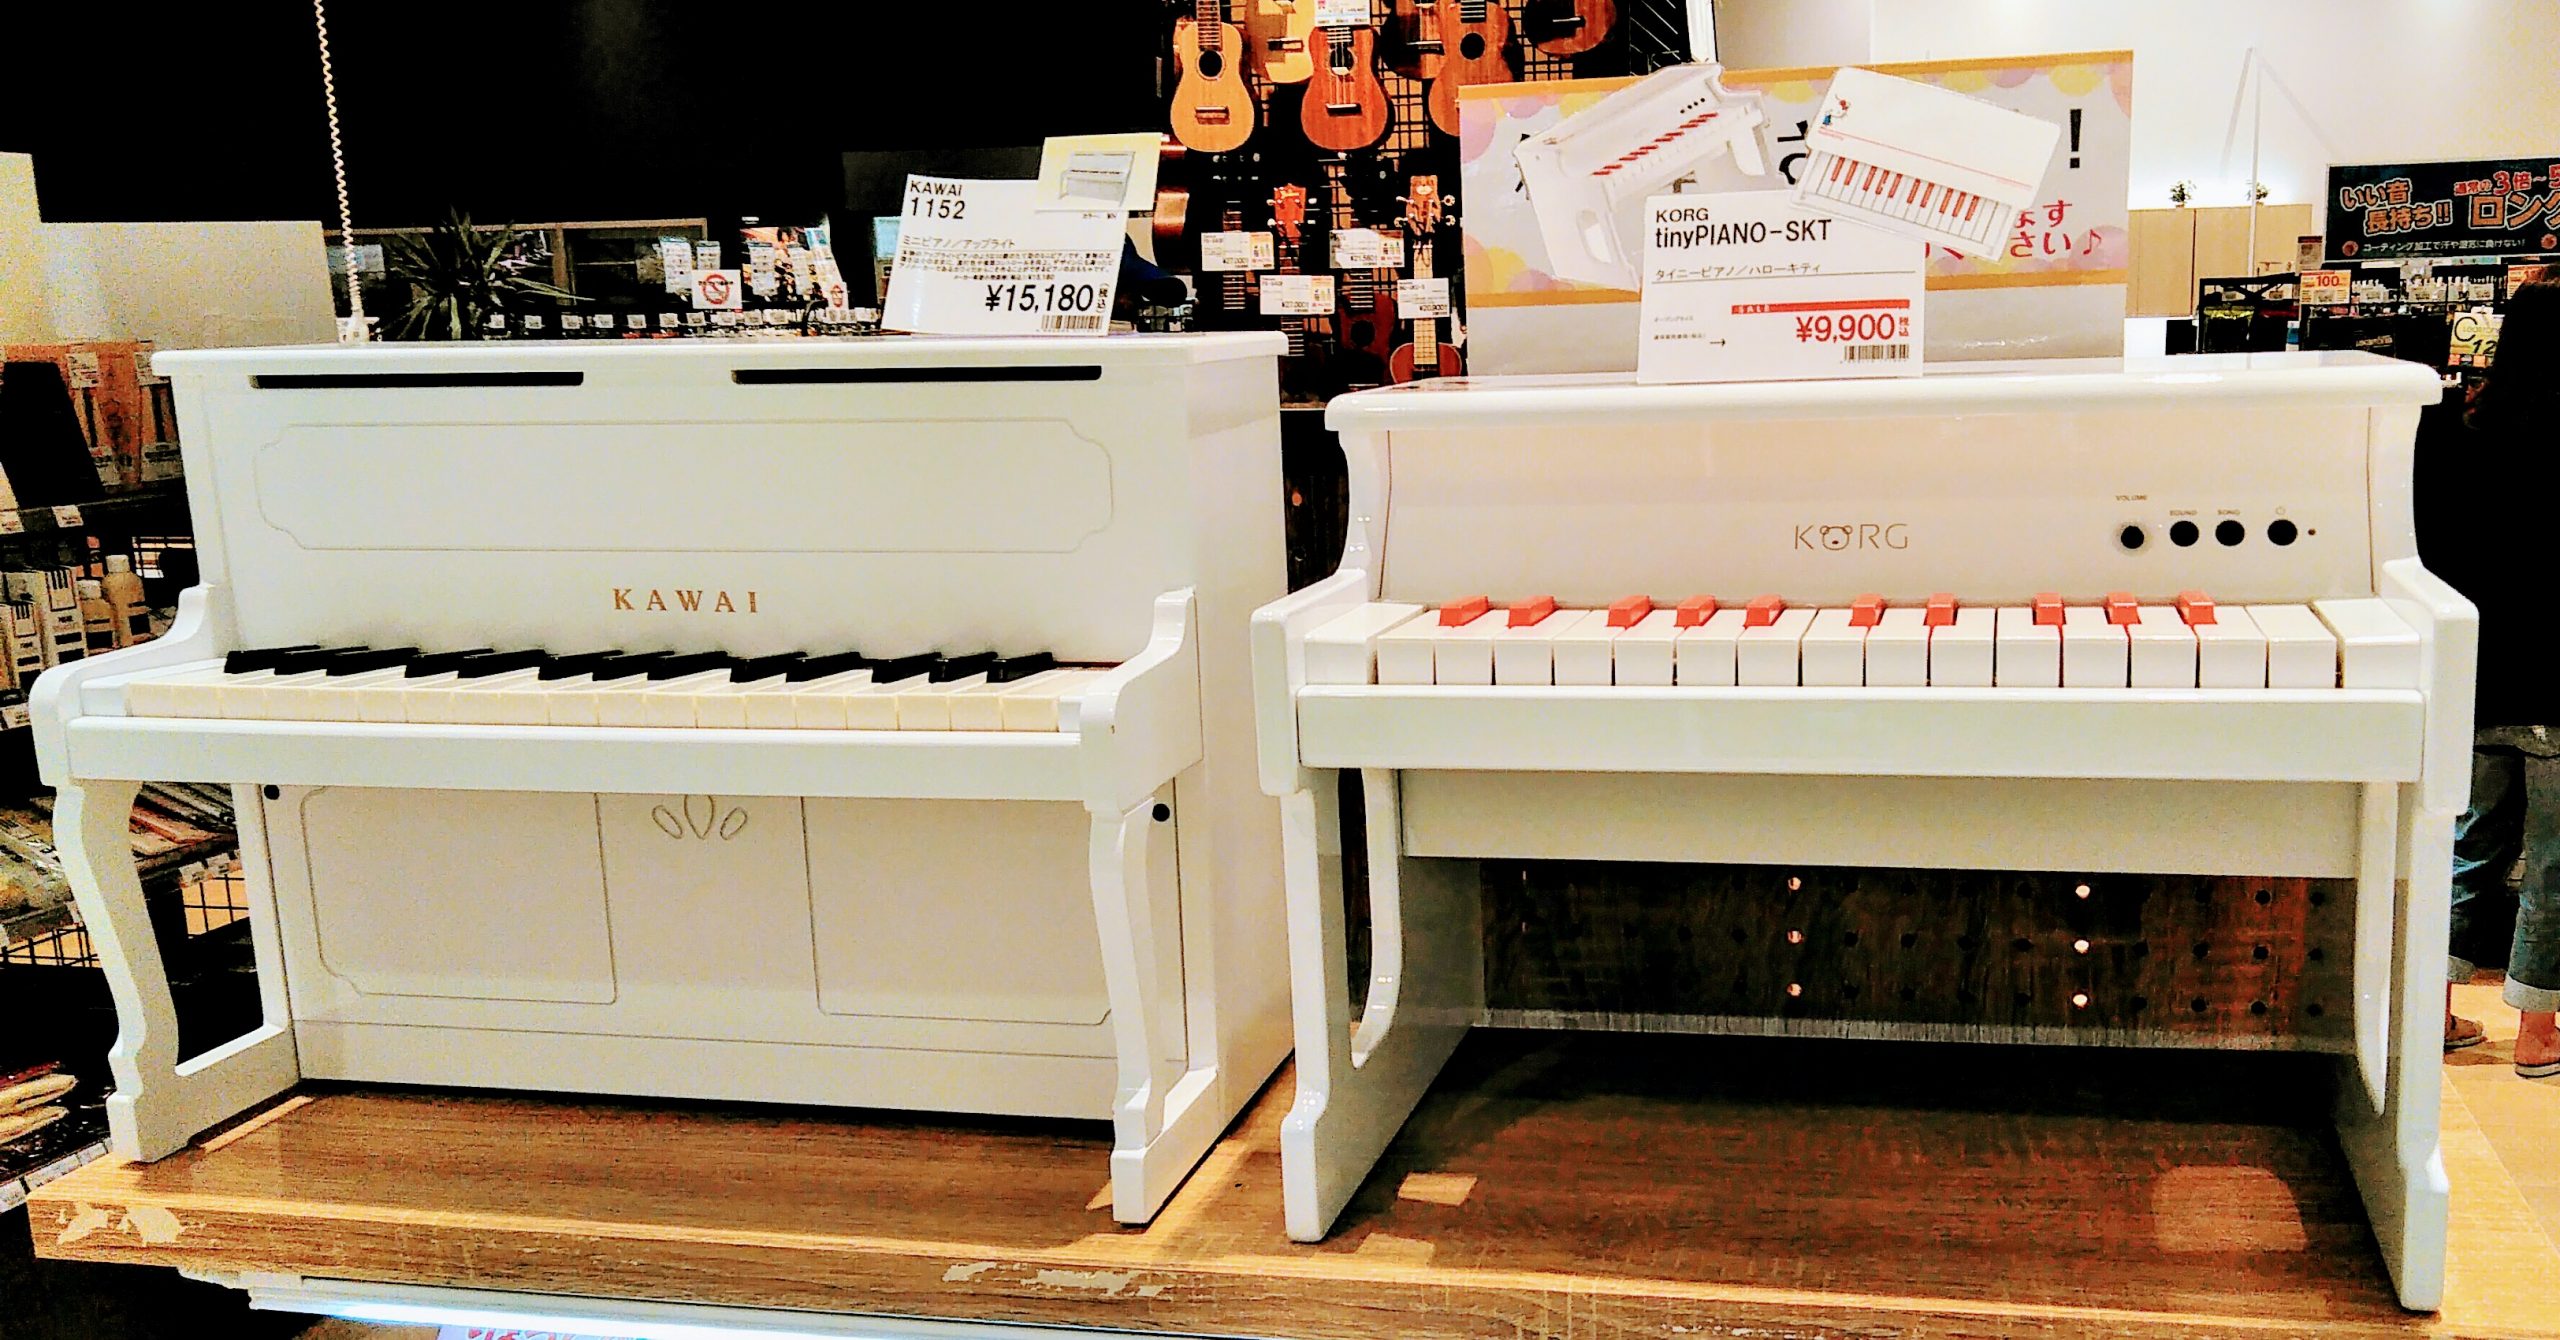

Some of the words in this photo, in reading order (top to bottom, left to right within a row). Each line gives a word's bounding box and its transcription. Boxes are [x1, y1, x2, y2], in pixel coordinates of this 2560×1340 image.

[909, 180, 963, 197] KAWAI
[2340, 176, 2413, 212] いい音
[910, 197, 965, 220] 1152
[1656, 207, 1710, 223] KORG
[1655, 218, 1832, 250] tinyPIANO-SKT
[985, 283, 1094, 314] ¥15,180
[1795, 312, 1896, 343] ¥9,900
[612, 587, 758, 613] KAWAI
